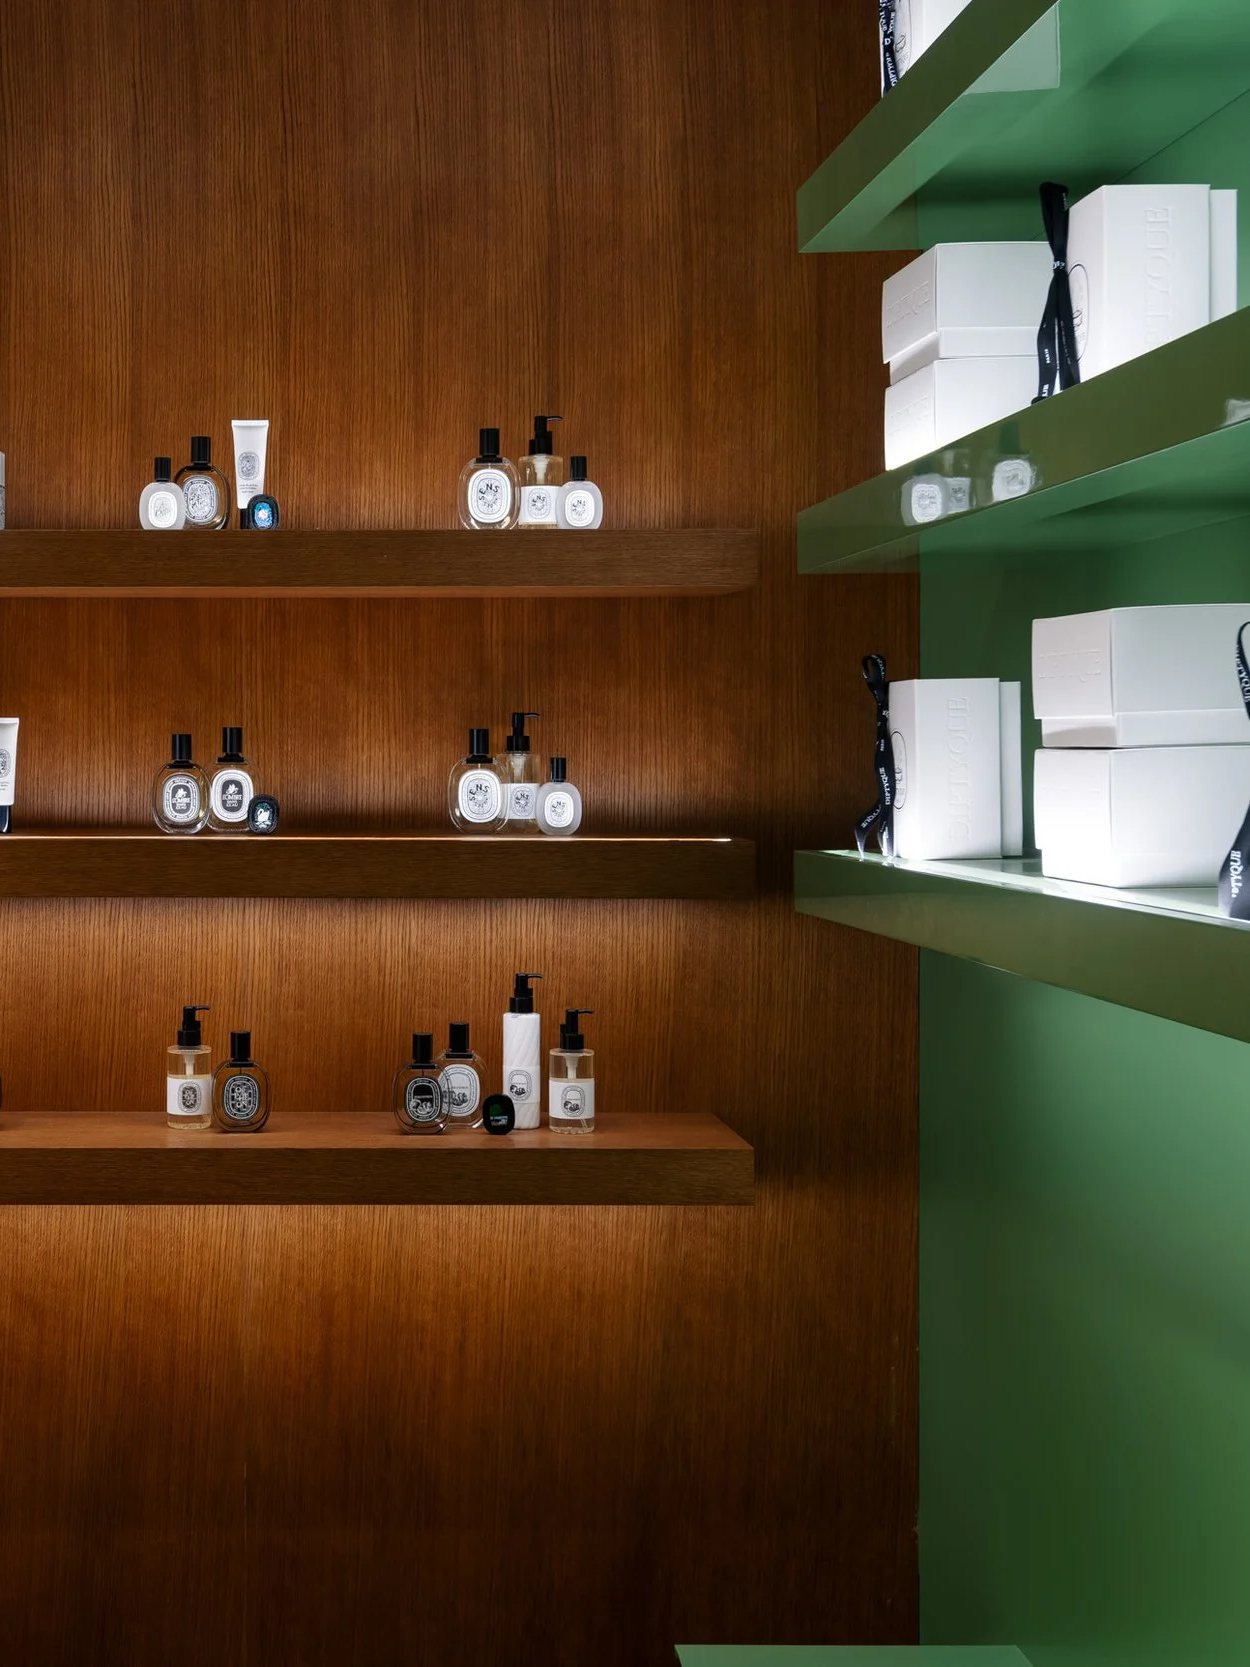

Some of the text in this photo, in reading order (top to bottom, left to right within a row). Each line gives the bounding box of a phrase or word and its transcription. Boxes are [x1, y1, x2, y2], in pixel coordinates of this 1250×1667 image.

[886, 52, 898, 87] DIPTYQU
[1145, 206, 1174, 343] PTYQUE
[878, 766, 891, 806] DIPTYQUE
